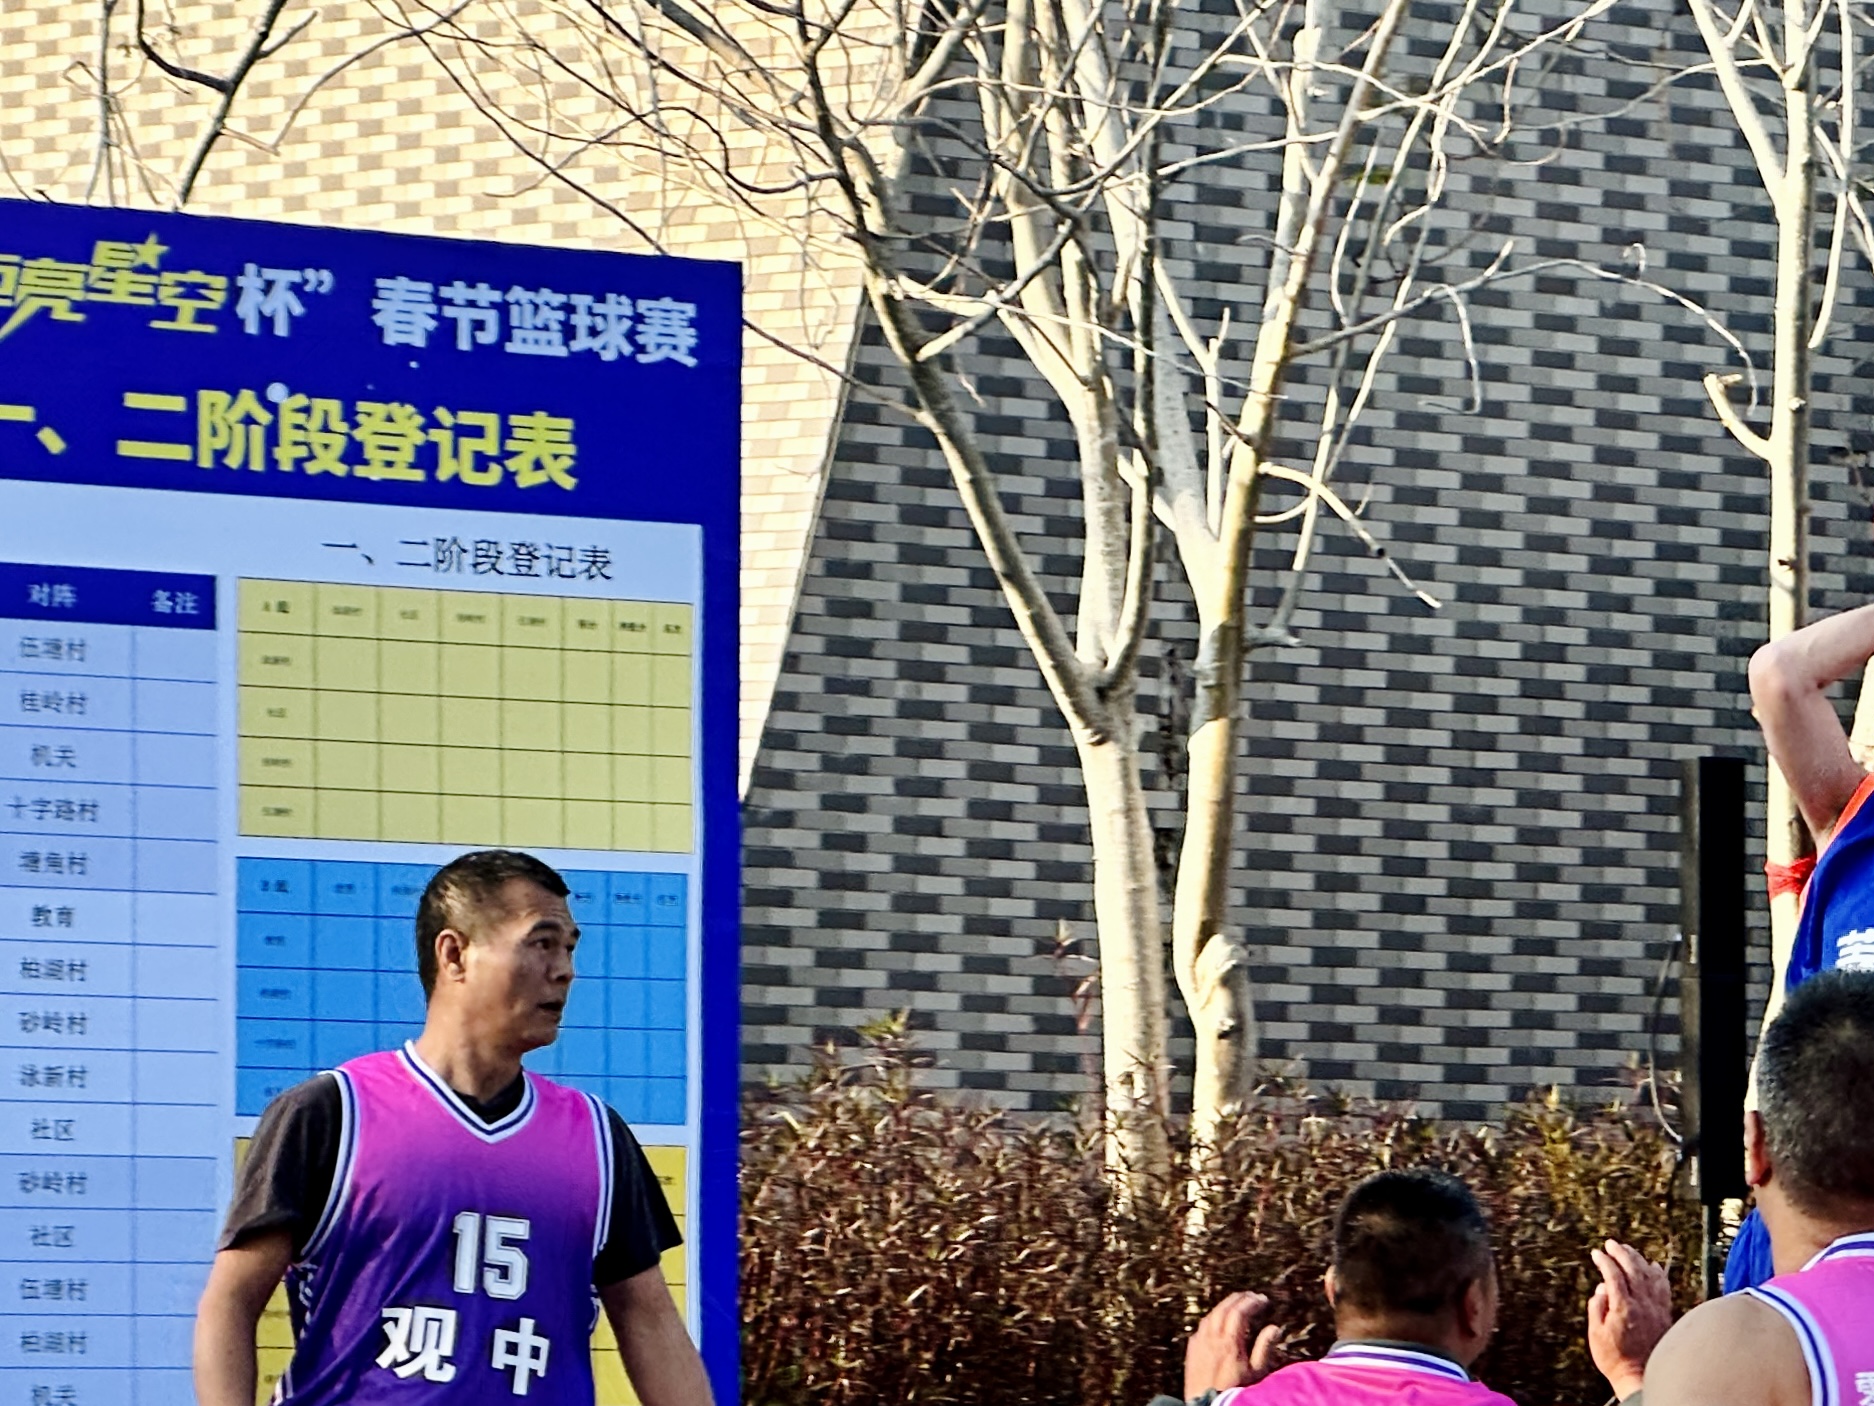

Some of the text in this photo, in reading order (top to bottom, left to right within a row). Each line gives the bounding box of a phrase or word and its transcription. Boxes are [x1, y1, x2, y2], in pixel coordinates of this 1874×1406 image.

[372, 276, 698, 367] 春节篮球赛
[322, 536, 613, 581] 一、二阶段登记表
[27, 583, 200, 614] 对阵 备注
[5, 796, 100, 823] 十字路村
[32, 905, 75, 928] 教育
[31, 1118, 76, 1141] 社区
[30, 1225, 76, 1248] 社区
[453, 1211, 530, 1301] 15
